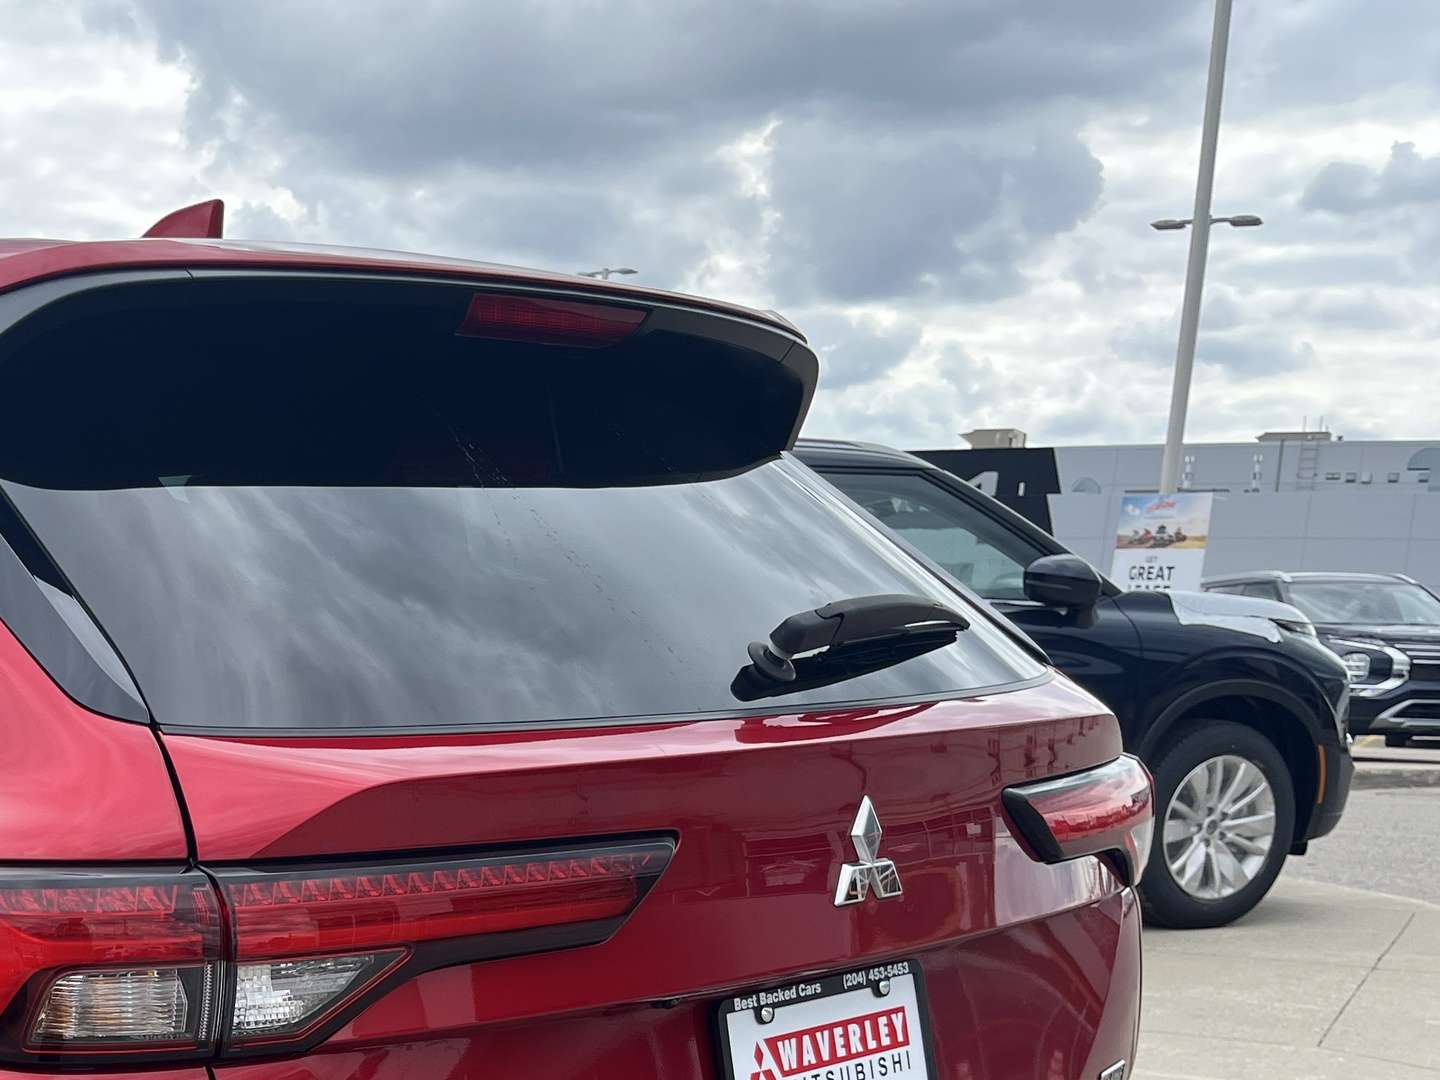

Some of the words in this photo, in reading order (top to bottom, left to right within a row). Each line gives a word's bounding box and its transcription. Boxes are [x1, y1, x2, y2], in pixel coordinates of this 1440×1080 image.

[1128, 565, 1175, 581] GREAT
[733, 994, 757, 1011] Best
[759, 985, 797, 1005] Backed
[798, 981, 822, 998] Cars
[843, 971, 867, 990] (204)
[868, 961, 910, 982] 453-5453
[776, 1011, 904, 1071] WAVERLEY
